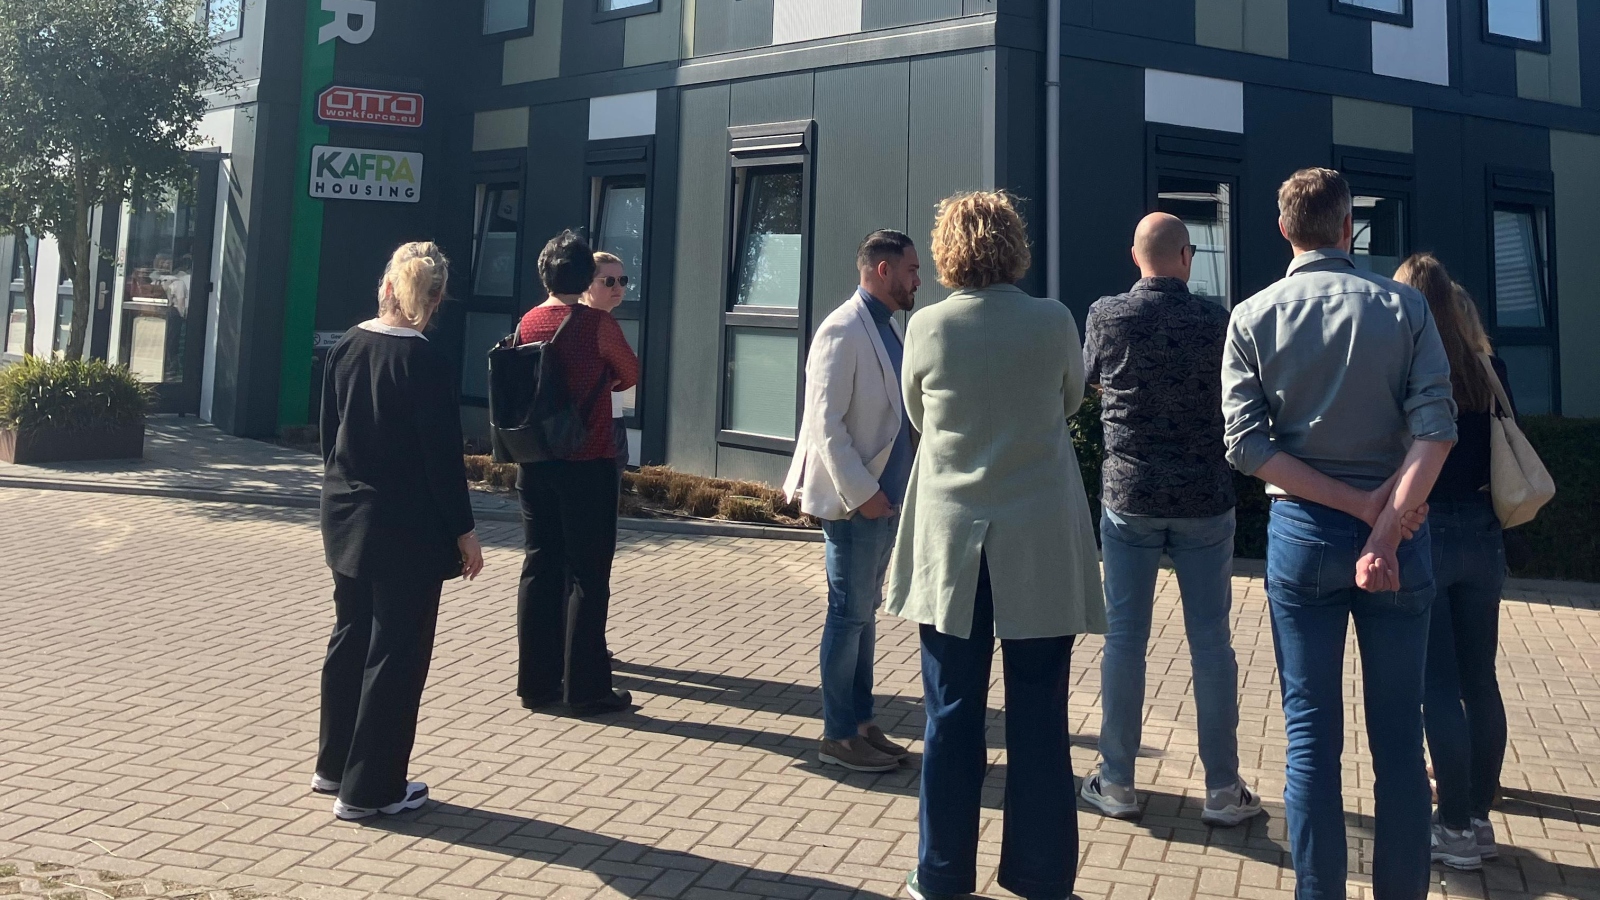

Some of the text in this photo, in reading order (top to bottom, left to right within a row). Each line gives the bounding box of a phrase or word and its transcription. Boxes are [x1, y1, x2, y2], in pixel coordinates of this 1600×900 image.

[326, 90, 417, 115] OTTO
[325, 109, 416, 123] workforce.eu
[316, 151, 416, 184] KAFRA
[315, 181, 415, 198] HOUSING
